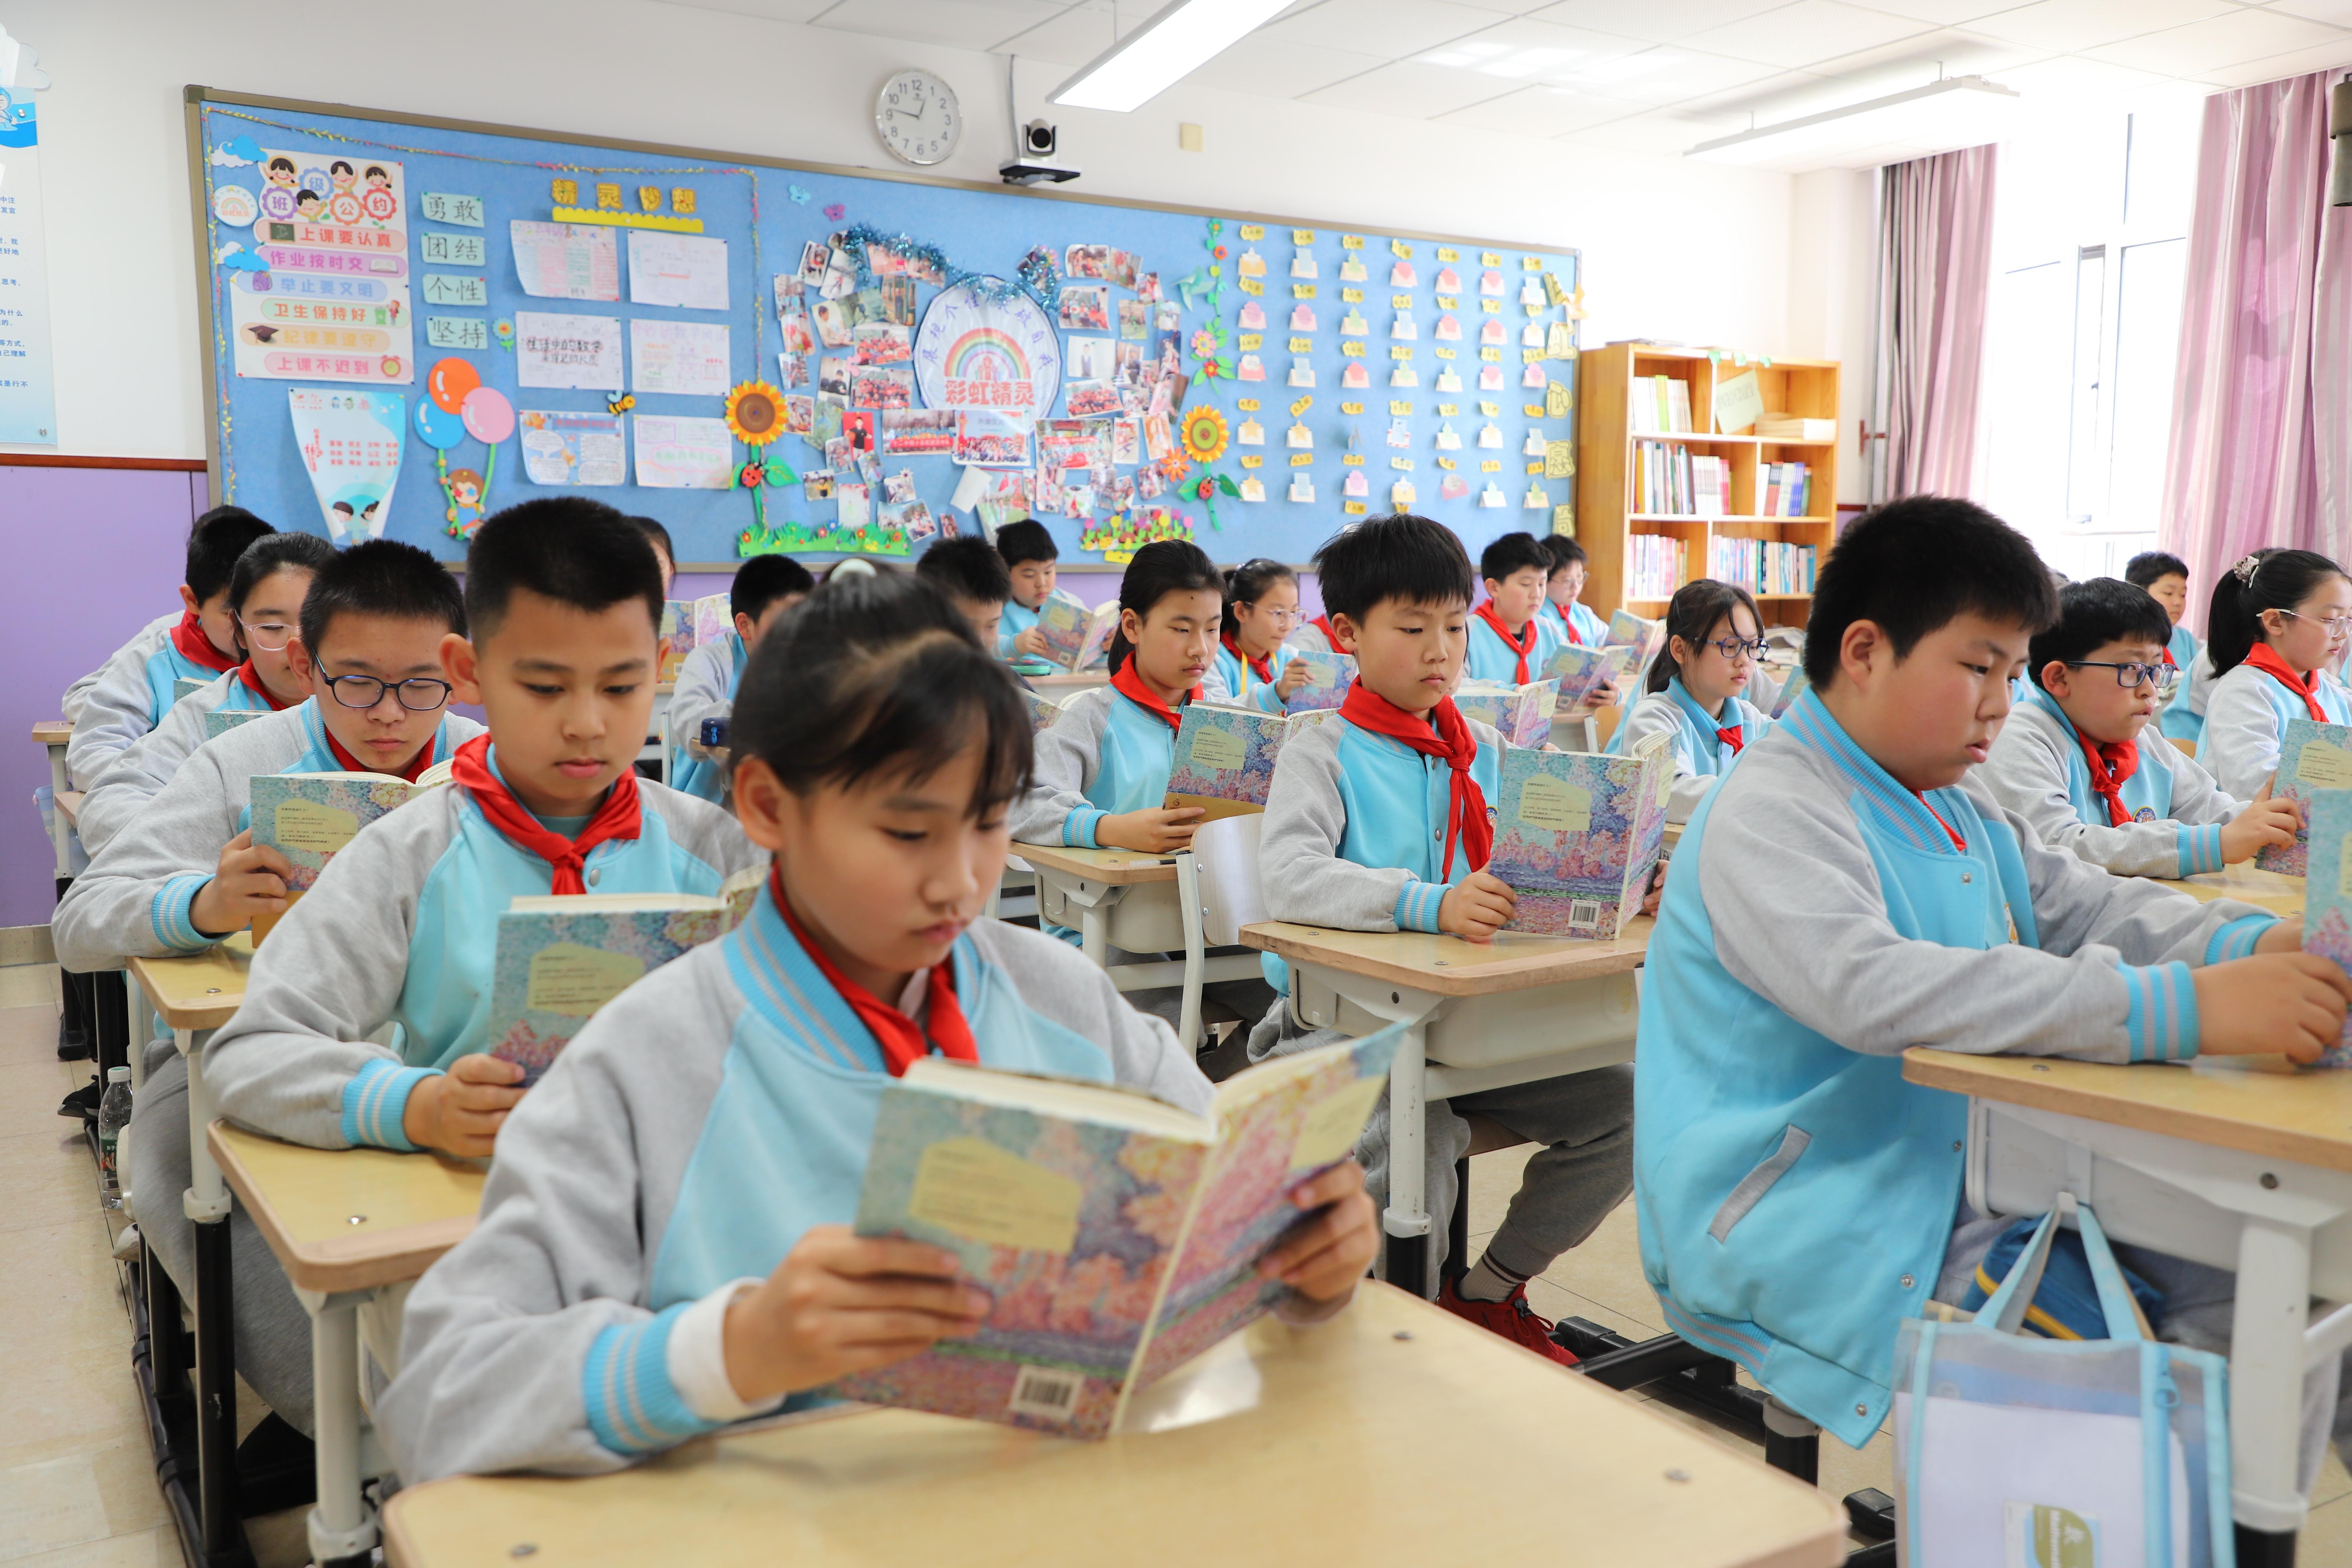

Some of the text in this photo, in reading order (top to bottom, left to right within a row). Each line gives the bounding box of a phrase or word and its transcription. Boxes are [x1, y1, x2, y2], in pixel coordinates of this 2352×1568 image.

[899, 83, 908, 94] 11
[912, 80, 923, 91] 12
[930, 86, 935, 96] 1
[888, 94, 899, 104] 10
[940, 98, 946, 109] 2
[886, 109, 893, 120] 9
[945, 115, 951, 126] 3
[891, 126, 898, 137] 8
[942, 131, 948, 141] 4
[903, 139, 909, 149] 7
[917, 144, 924, 155] 6
[931, 141, 938, 152] 5
[272, 177, 388, 215] 班级公约
[428, 196, 479, 222] 勇敢
[300, 228, 392, 247] 上课要认真
[427, 236, 478, 261] 团结
[270, 251, 363, 271] 作业按时交
[281, 278, 372, 297] 举止要文明
[427, 277, 482, 302] 个性
[274, 303, 366, 322] 卫生保持好
[284, 330, 376, 346] 纪律要遵守
[432, 320, 484, 348] 坚持
[527, 336, 603, 353] 生活中的数学
[277, 357, 369, 374] 上课不迟到
[945, 380, 1034, 406] 彩虹精灵
